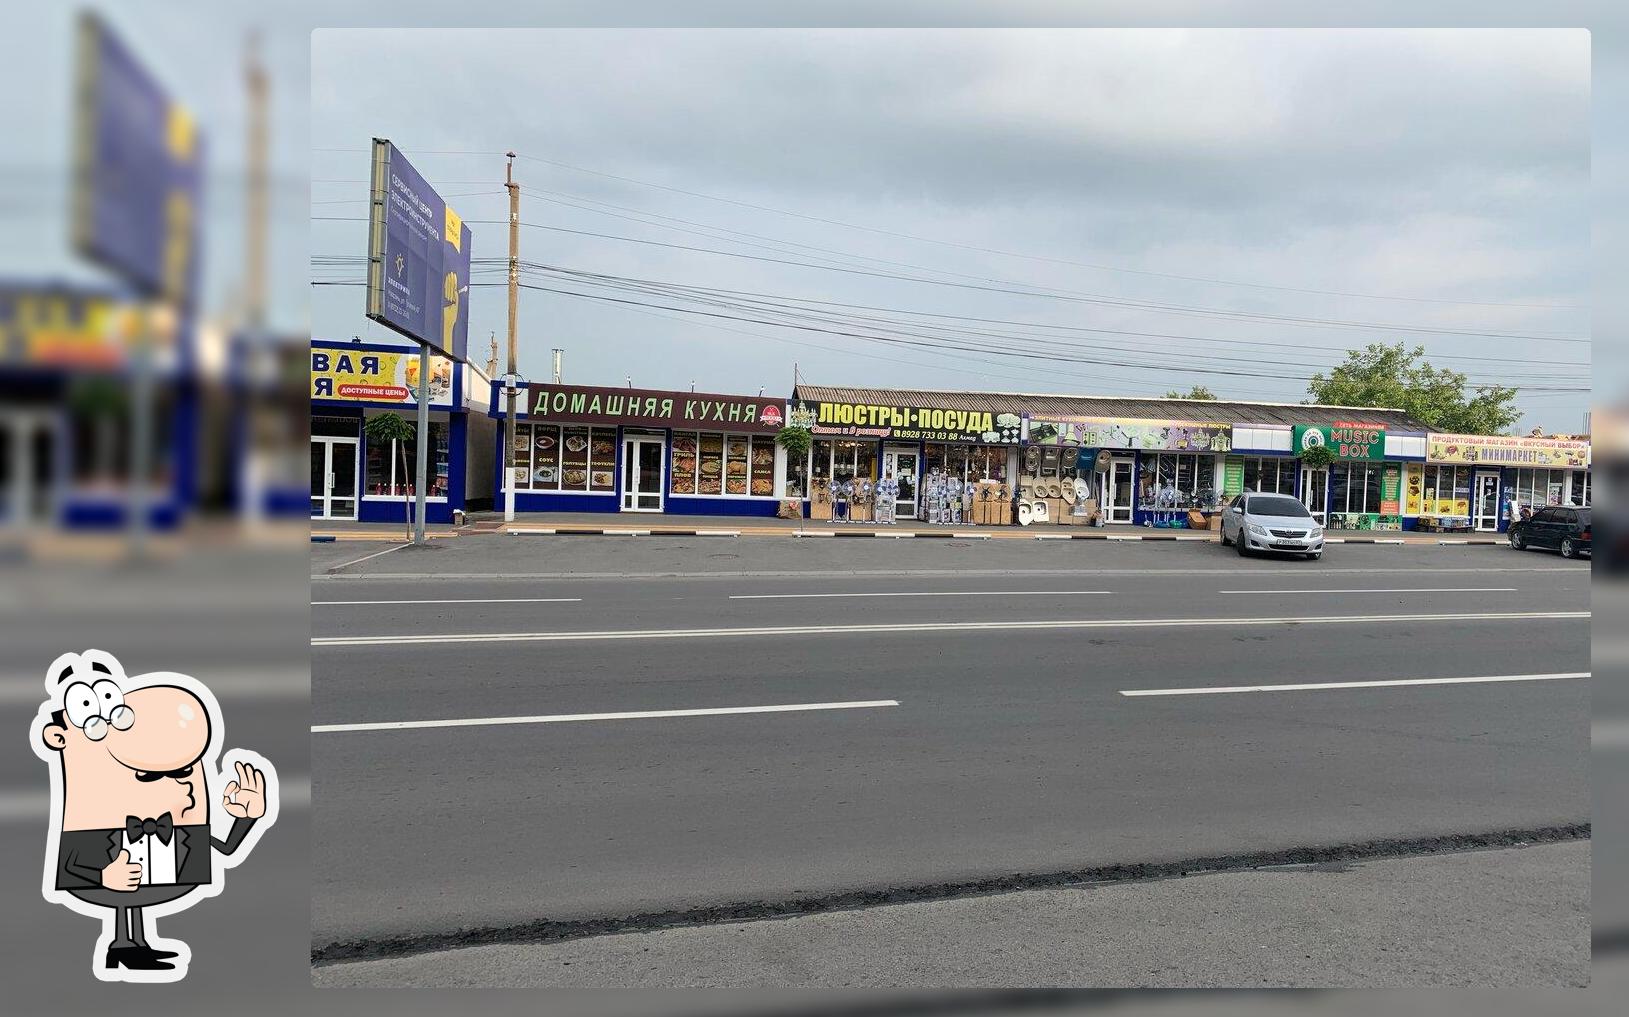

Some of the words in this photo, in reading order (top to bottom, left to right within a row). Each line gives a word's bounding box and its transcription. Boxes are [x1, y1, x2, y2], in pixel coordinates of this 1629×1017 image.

[340, 387, 384, 396] ДОСТУПНЫЕ
[385, 388, 407, 397] ЦЕНЫ
[533, 391, 674, 419] ДОМАШНЯЯ
[684, 400, 758, 423] КУХНЯ
[901, 430, 921, 439] 8928
[922, 431, 936, 440] 733
[937, 432, 947, 440] 03
[948, 432, 959, 441] 88
[1330, 428, 1380, 445] MUSIC
[1432, 436, 1485, 445] ПРОДУКТОВЫЙ
[1339, 443, 1370, 458] BOX
[1481, 447, 1538, 463] МИНИМАРКЕТ
